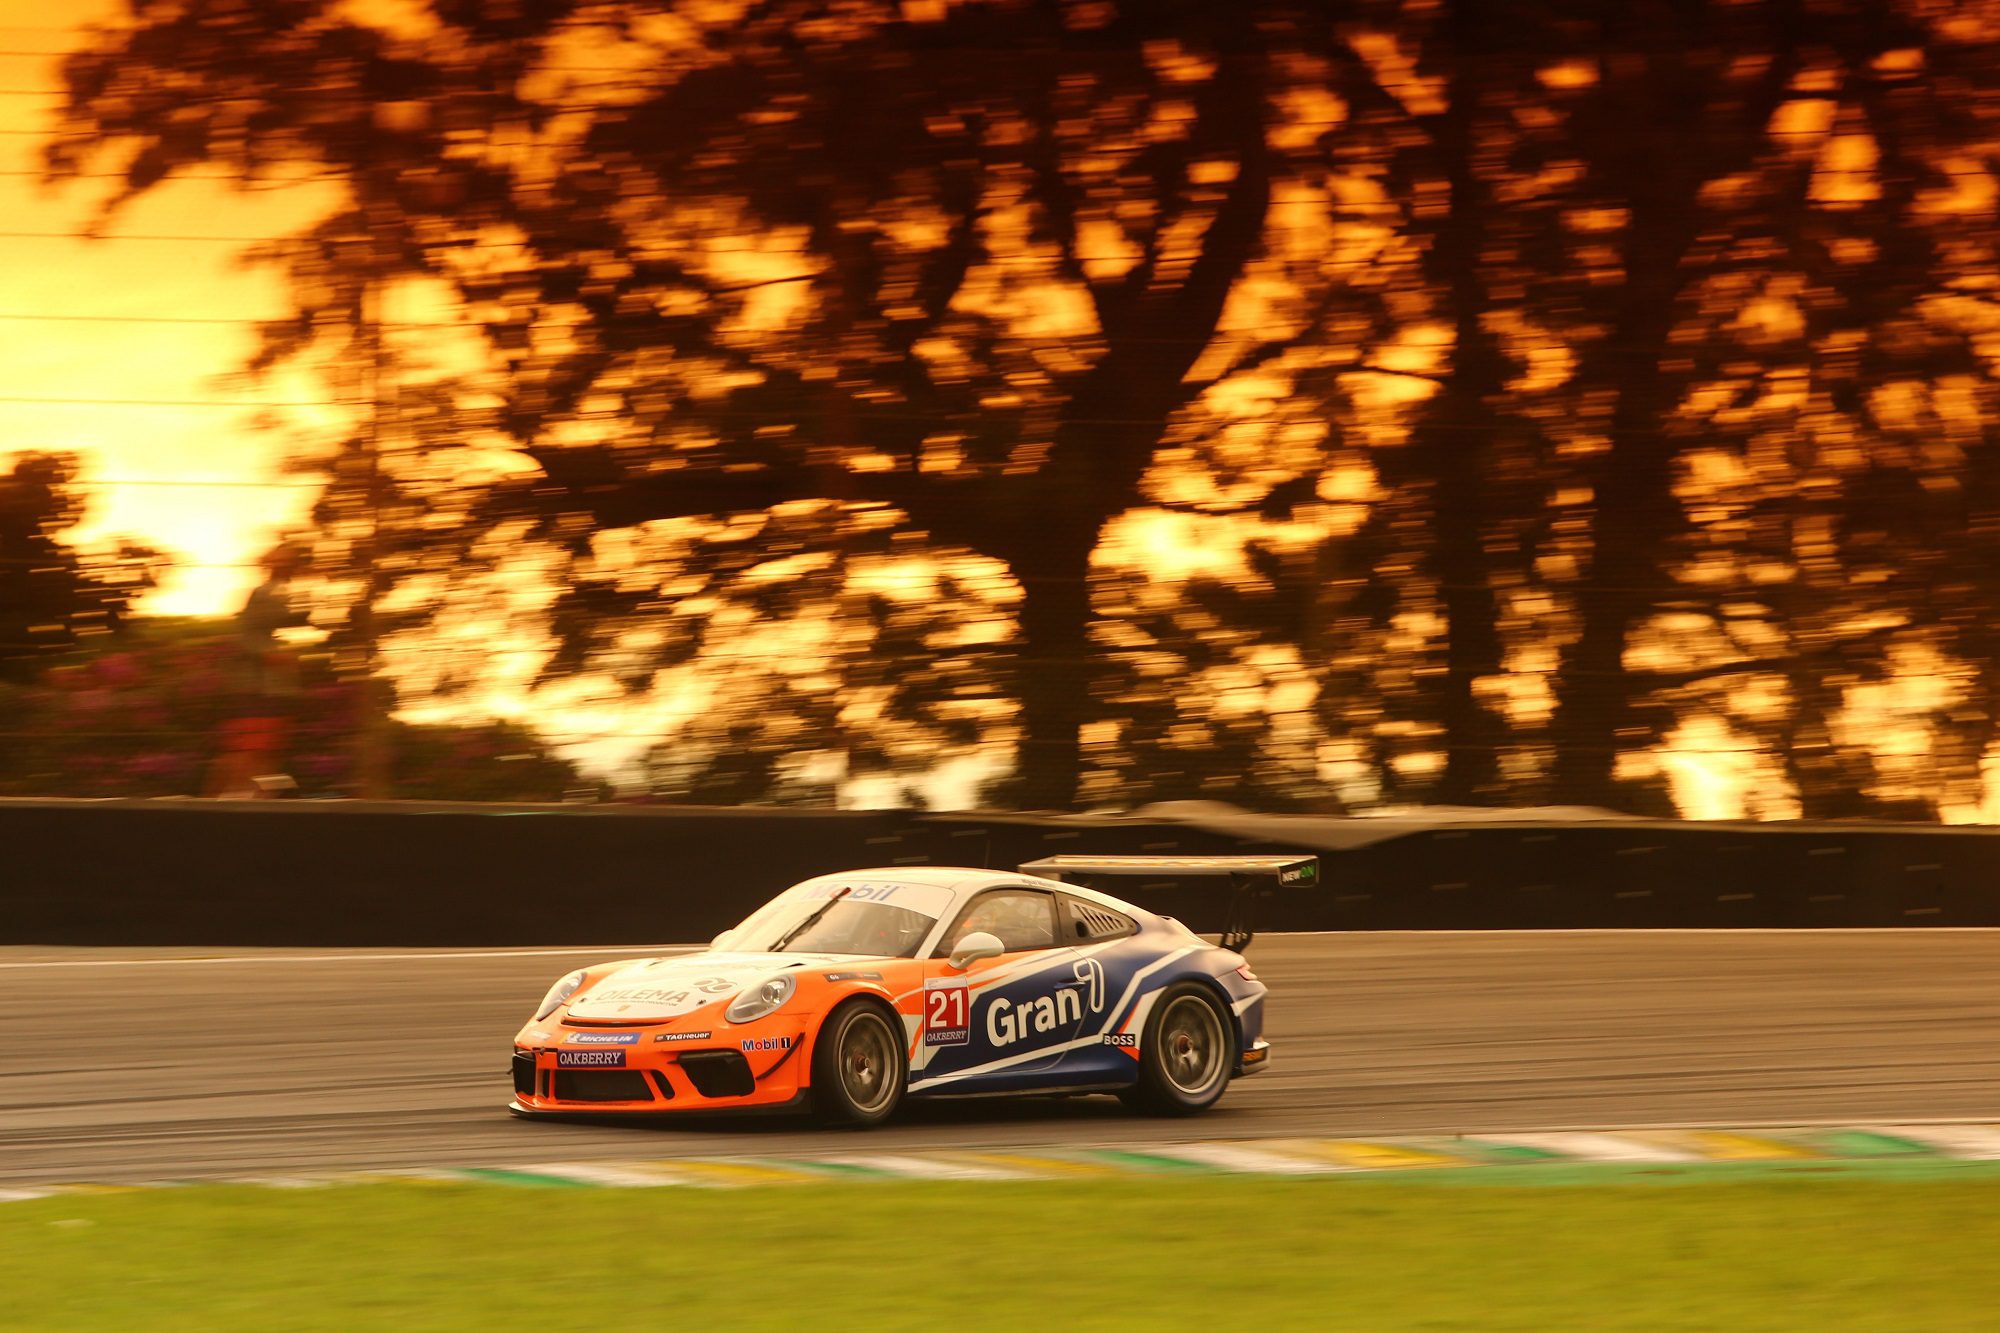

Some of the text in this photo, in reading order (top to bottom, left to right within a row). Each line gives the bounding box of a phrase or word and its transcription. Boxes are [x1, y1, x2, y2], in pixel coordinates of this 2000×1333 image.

[929, 989, 963, 1027] 21
[987, 988, 1081, 1047] Gran
[579, 1034, 634, 1043] MICHELIN
[926, 1030, 967, 1042] OAKBERRY
[1104, 1035, 1134, 1045] BOSS
[742, 1037, 791, 1051] Mobil 1
[559, 1052, 621, 1065] OAKBERRY
